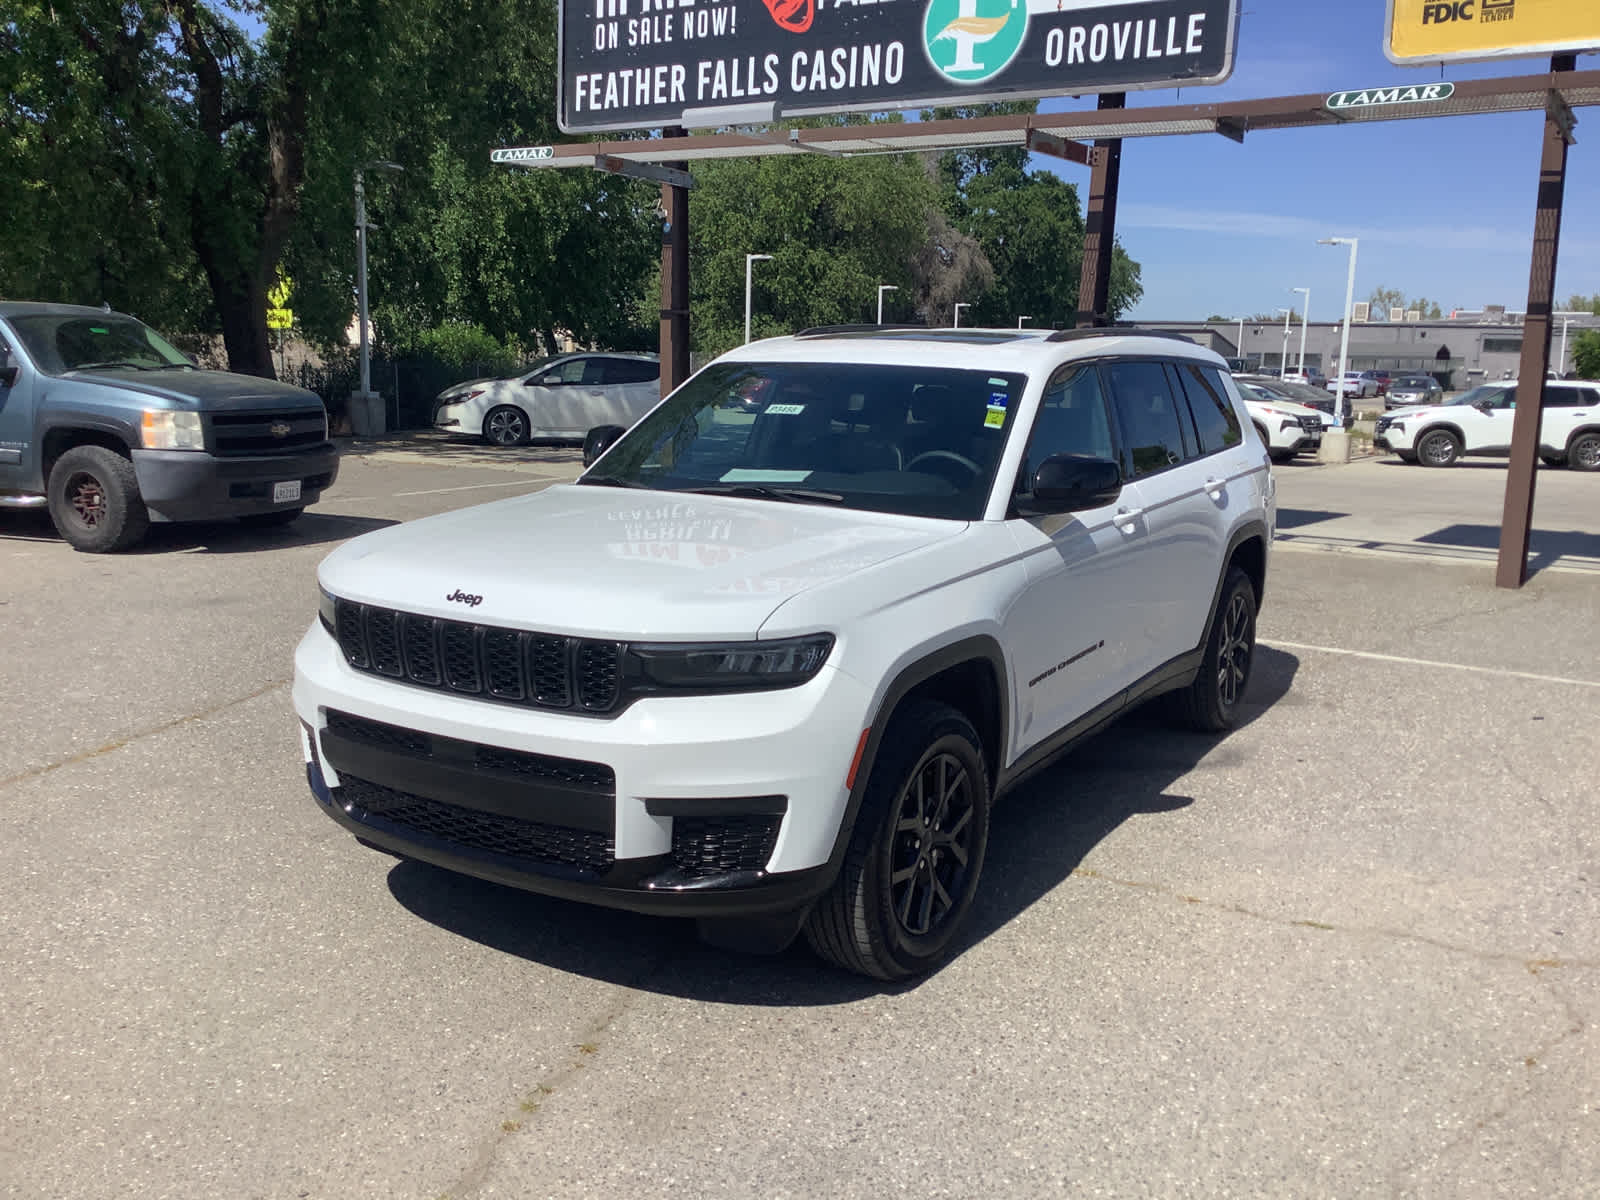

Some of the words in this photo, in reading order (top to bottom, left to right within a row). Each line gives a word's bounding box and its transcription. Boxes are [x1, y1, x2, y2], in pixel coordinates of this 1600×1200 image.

[1422, 0, 1475, 24] FDIC
[595, 22, 619, 51] ON
[628, 14, 674, 47] SALE
[683, 5, 737, 40] NOW!
[1044, 13, 1207, 68] OROVILLE
[575, 65, 686, 112] FEATHER
[697, 54, 779, 100] FALLS
[790, 41, 904, 92] CASINO
[1336, 84, 1442, 106] LAMAR
[496, 147, 549, 161] LAMAR
[446, 589, 484, 608] Jeep
